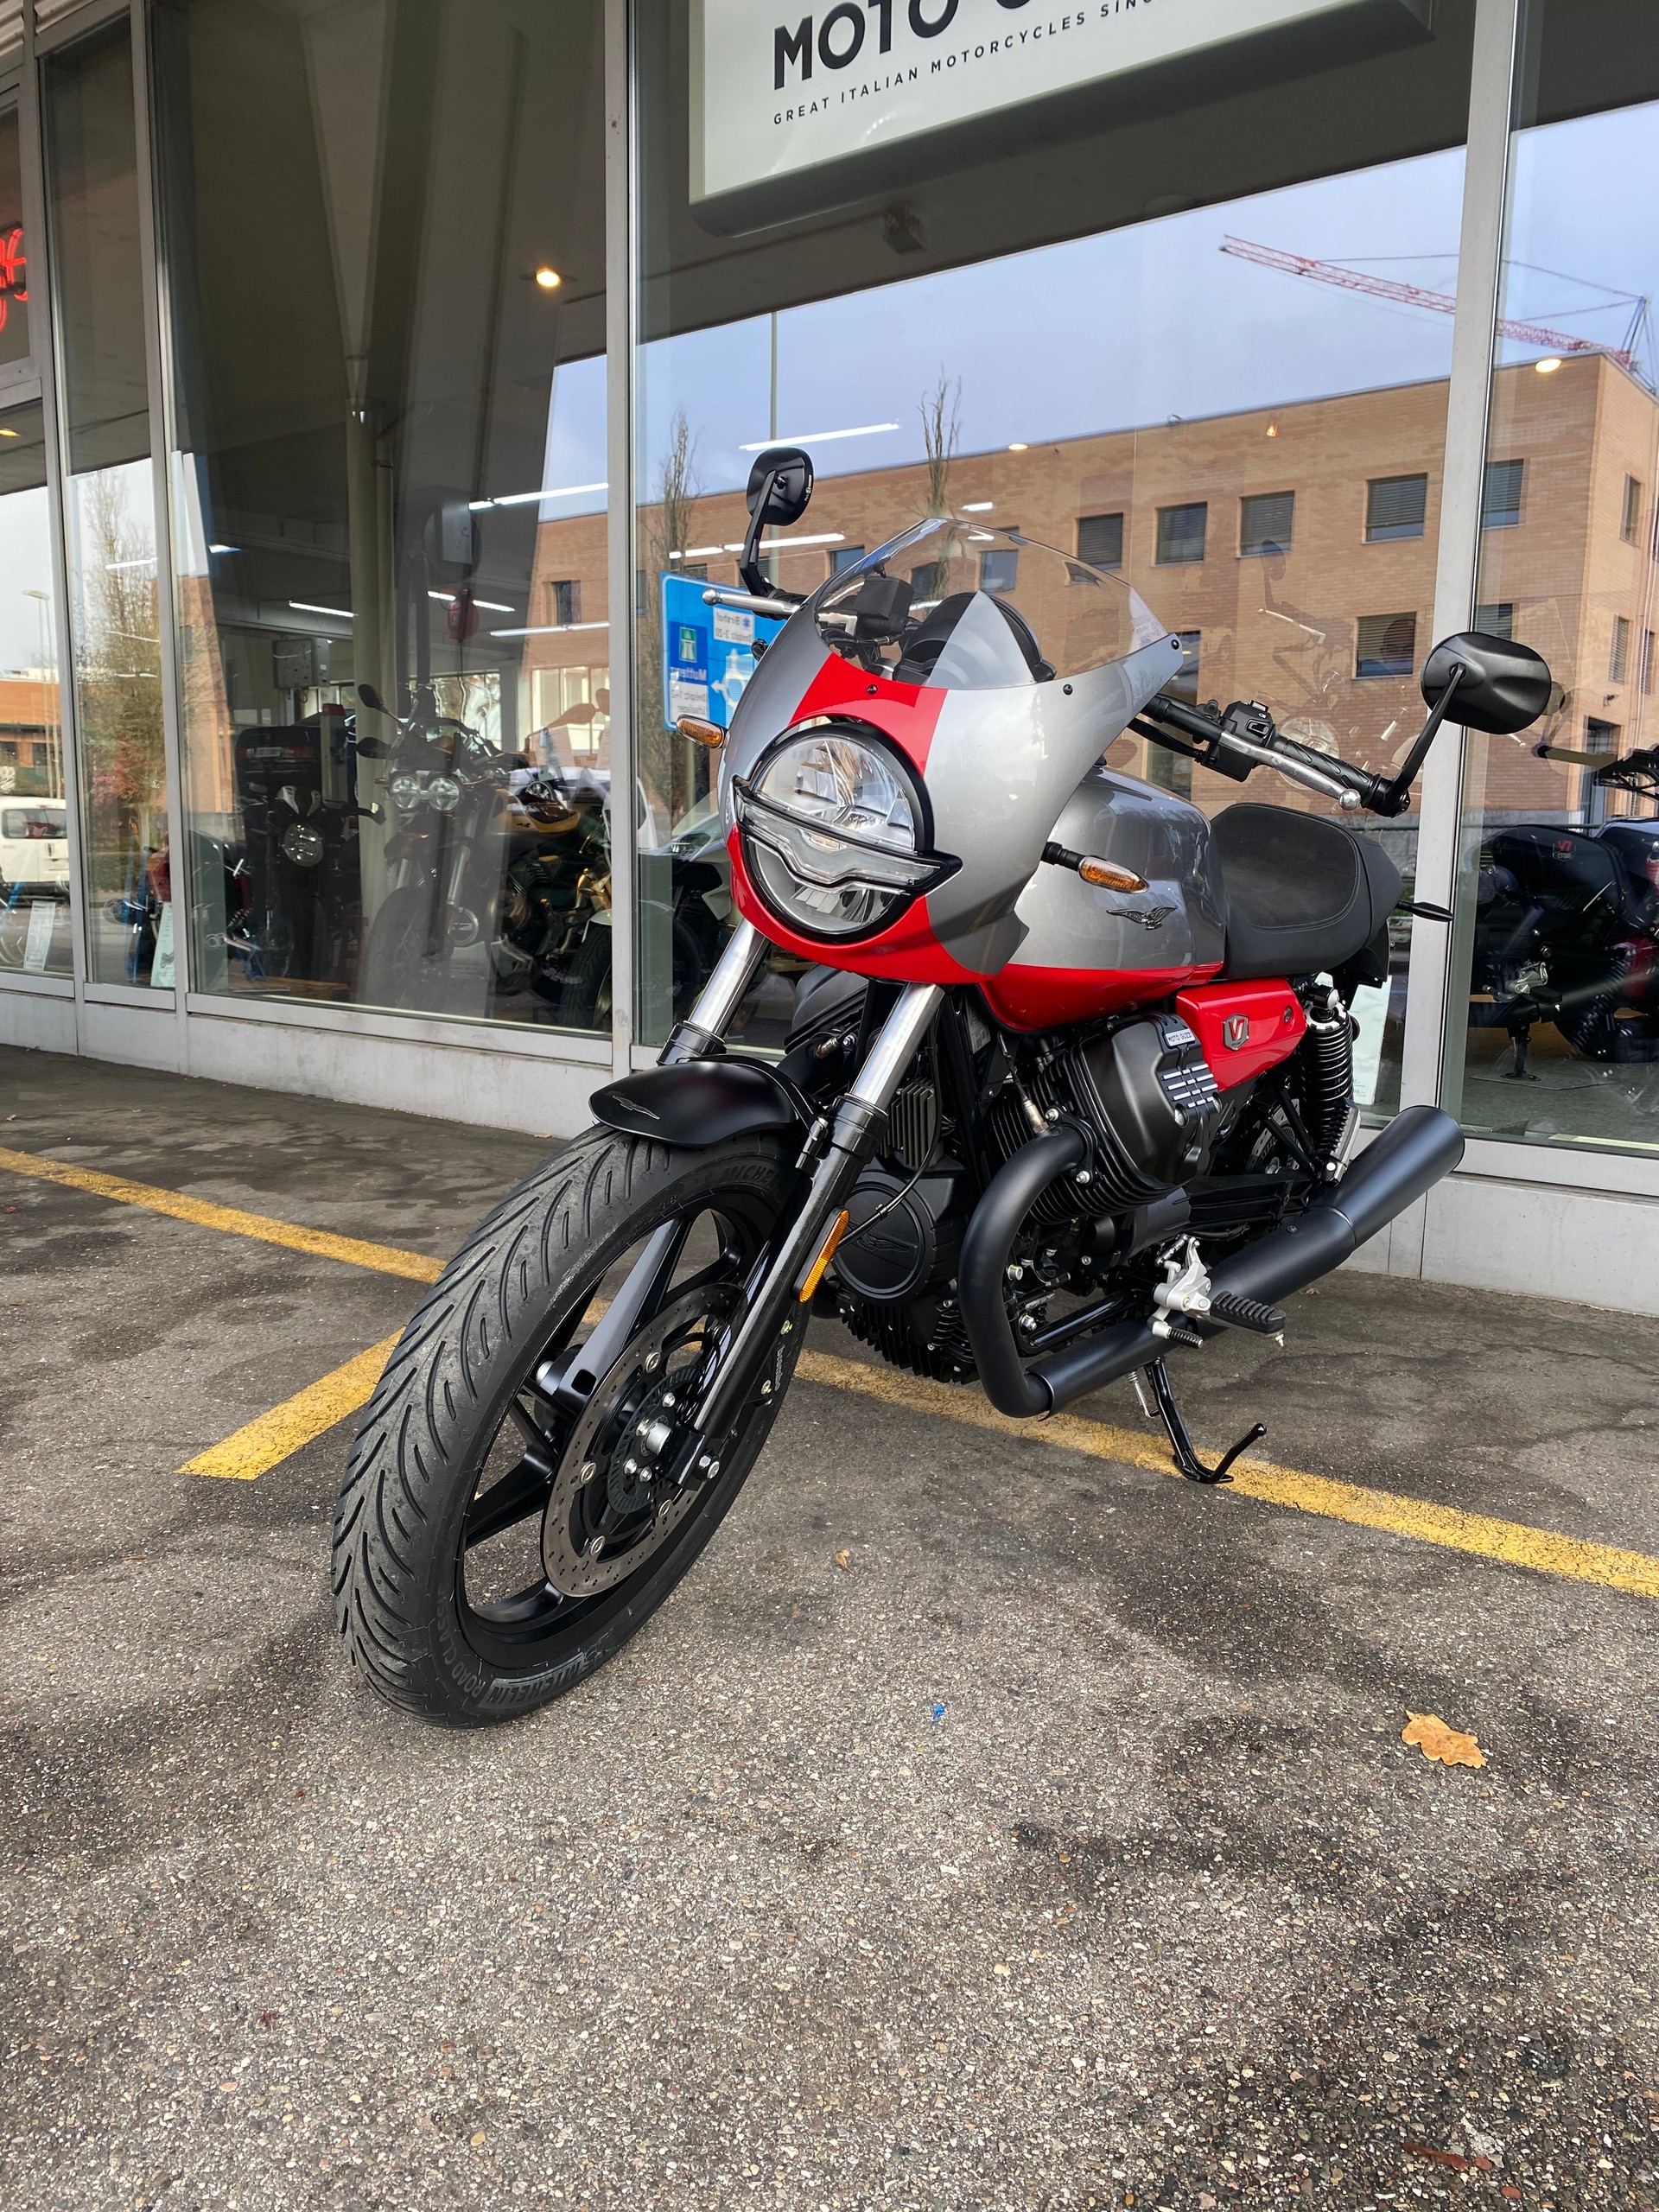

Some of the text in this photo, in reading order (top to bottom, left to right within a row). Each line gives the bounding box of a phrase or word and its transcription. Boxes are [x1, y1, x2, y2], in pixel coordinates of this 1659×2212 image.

[773, 0, 1154, 125] GREAT ITALIAN MOTORCYCLES SIN
[774, 0, 959, 90] MOTO
[1556, 840, 1573, 853] V7
[1168, 1034, 1180, 1043] MOTO
[451, 1660, 486, 1699] ROAD
[486, 1660, 583, 1704] MICHELIN
